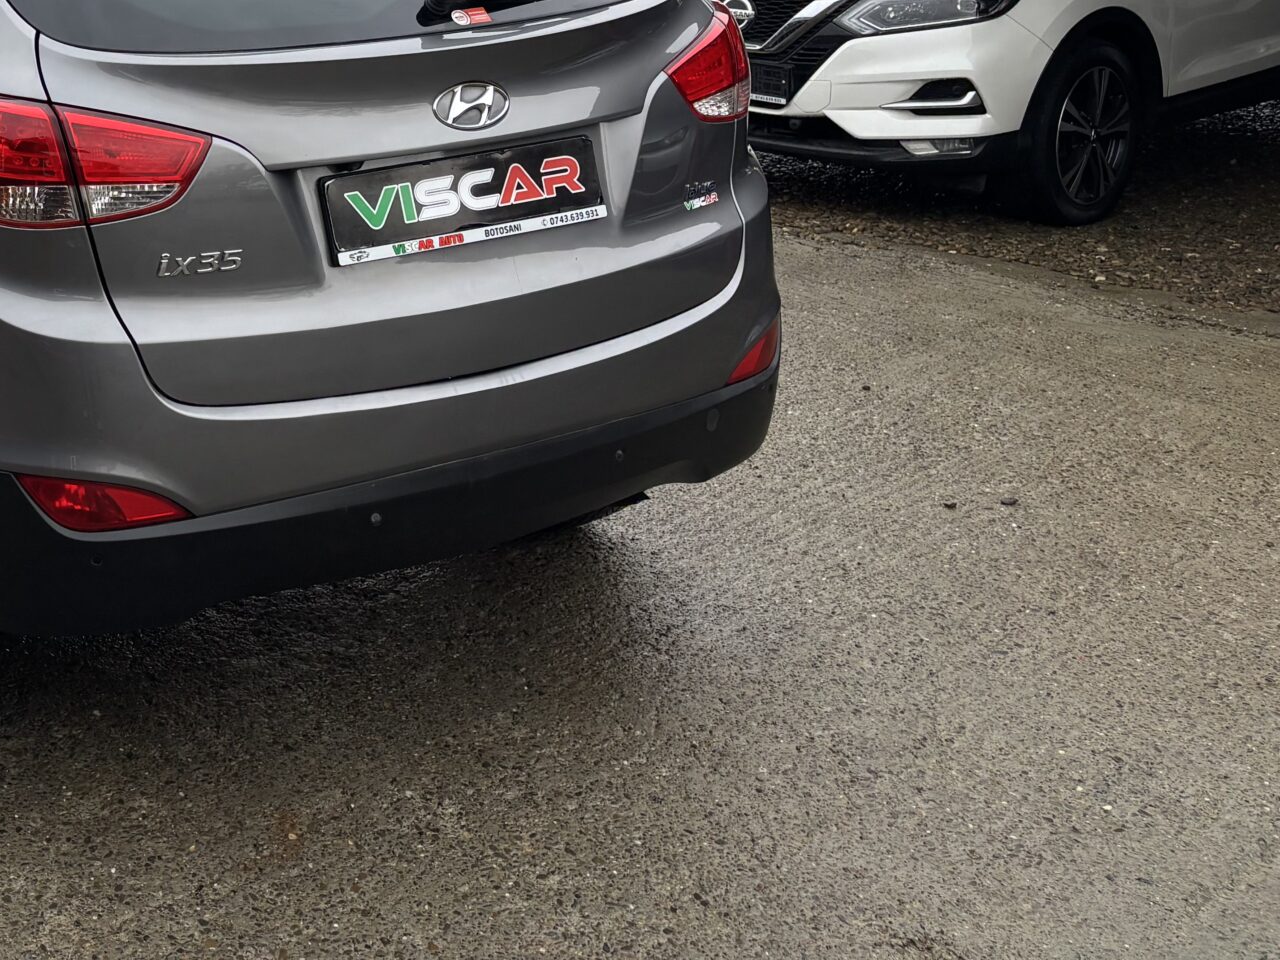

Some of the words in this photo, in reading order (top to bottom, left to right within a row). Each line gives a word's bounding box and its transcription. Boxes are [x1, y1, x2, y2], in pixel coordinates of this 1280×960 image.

[344, 155, 586, 230] VISCAR
[683, 192, 719, 211] VISCAR
[392, 239, 435, 256] VISCAR
[438, 233, 465, 247] AUTO
[484, 224, 522, 238] BOTOSANI
[549, 208, 600, 226] 0743.639.931
[158, 249, 244, 277] ix35
